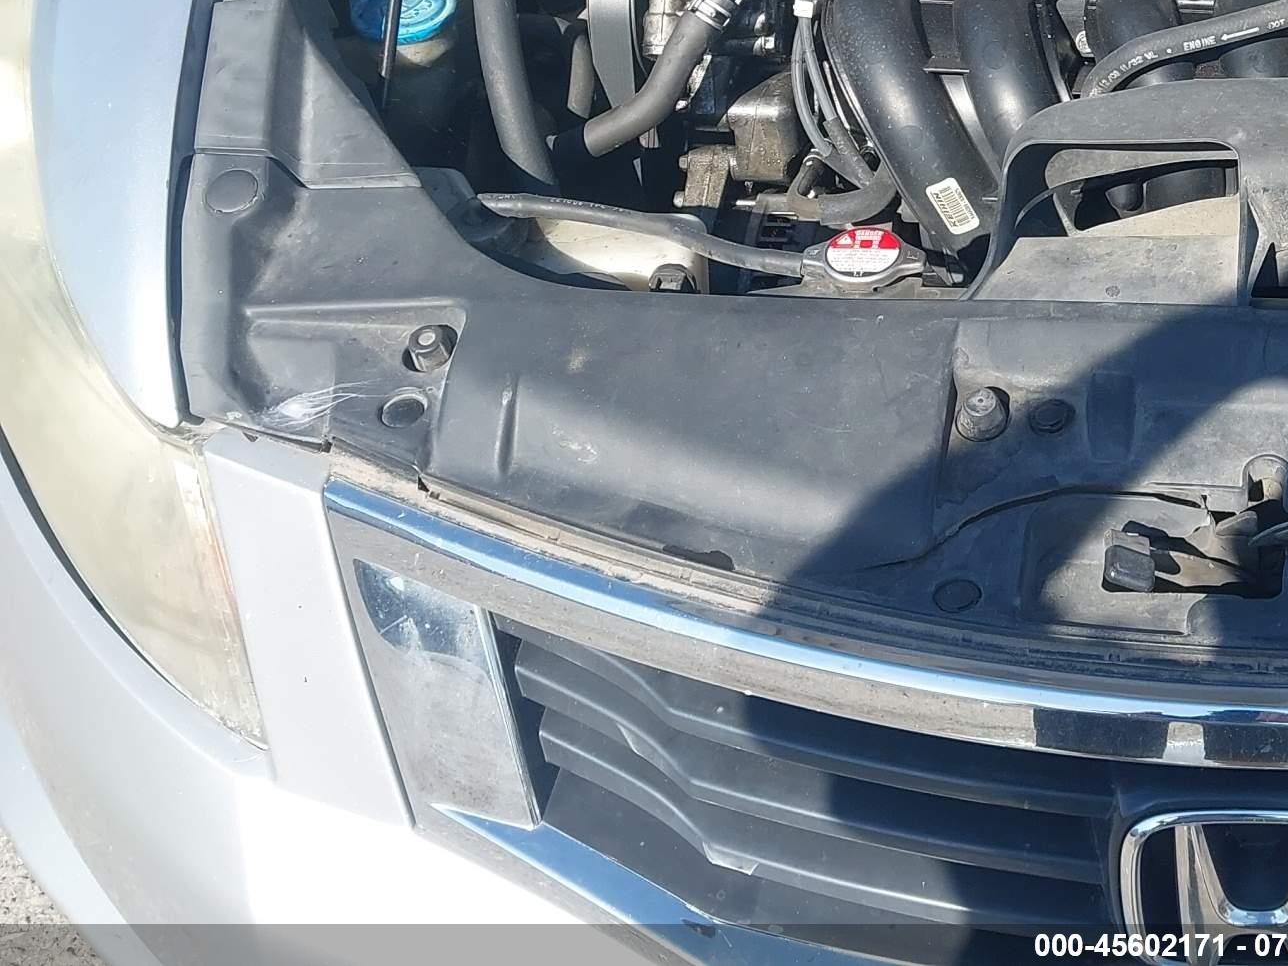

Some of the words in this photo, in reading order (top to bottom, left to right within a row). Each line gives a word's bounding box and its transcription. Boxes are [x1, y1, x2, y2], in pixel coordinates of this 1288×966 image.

[1183, 35, 1217, 51] ENGINE
[1267, 16, 1286, 30] DOT
[933, 192, 959, 227] KEIHIN
